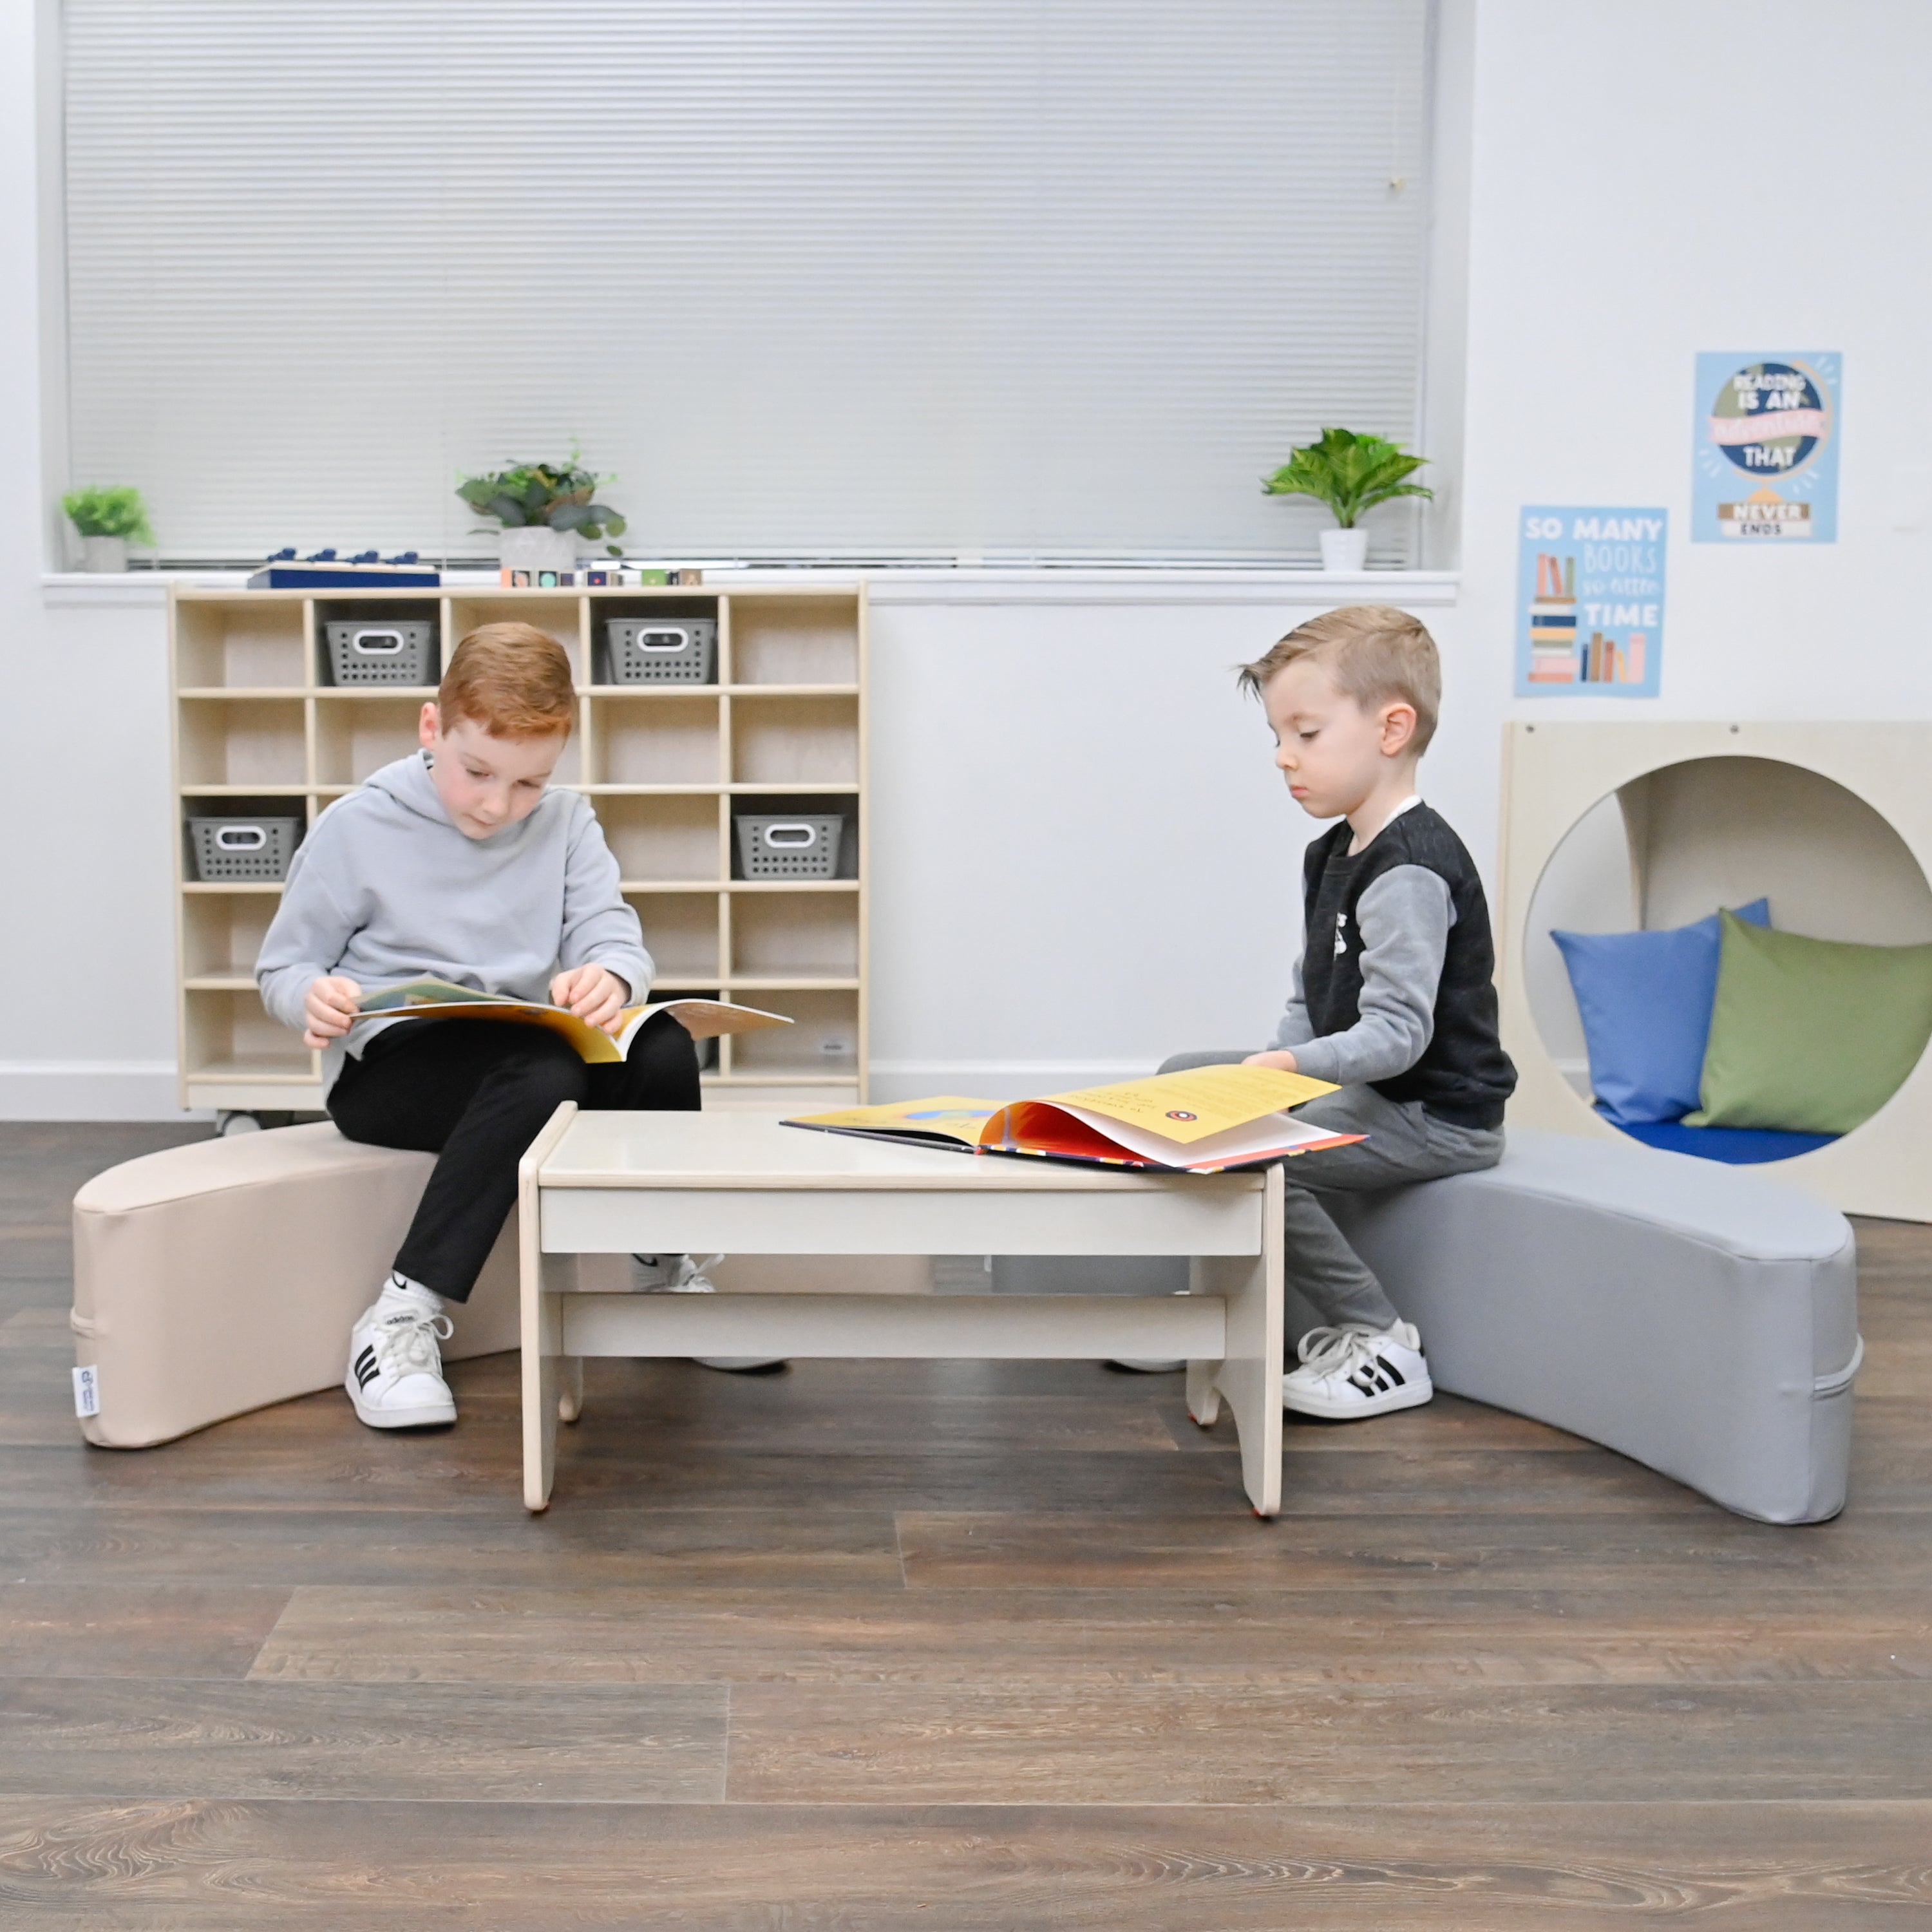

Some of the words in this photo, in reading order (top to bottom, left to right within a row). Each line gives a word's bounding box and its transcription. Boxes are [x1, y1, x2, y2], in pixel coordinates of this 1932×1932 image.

[1738, 391, 1759, 409] IS
[1765, 391, 1801, 409] AN
[1743, 446, 1797, 467] THAT
[1734, 504, 1802, 520] NEVER
[1525, 517, 1562, 540] SO
[1573, 517, 1663, 541] MANY
[1740, 523, 1781, 536] ENDS
[1584, 543, 1656, 574] BOOKS
[1584, 603, 1658, 627] TIME
